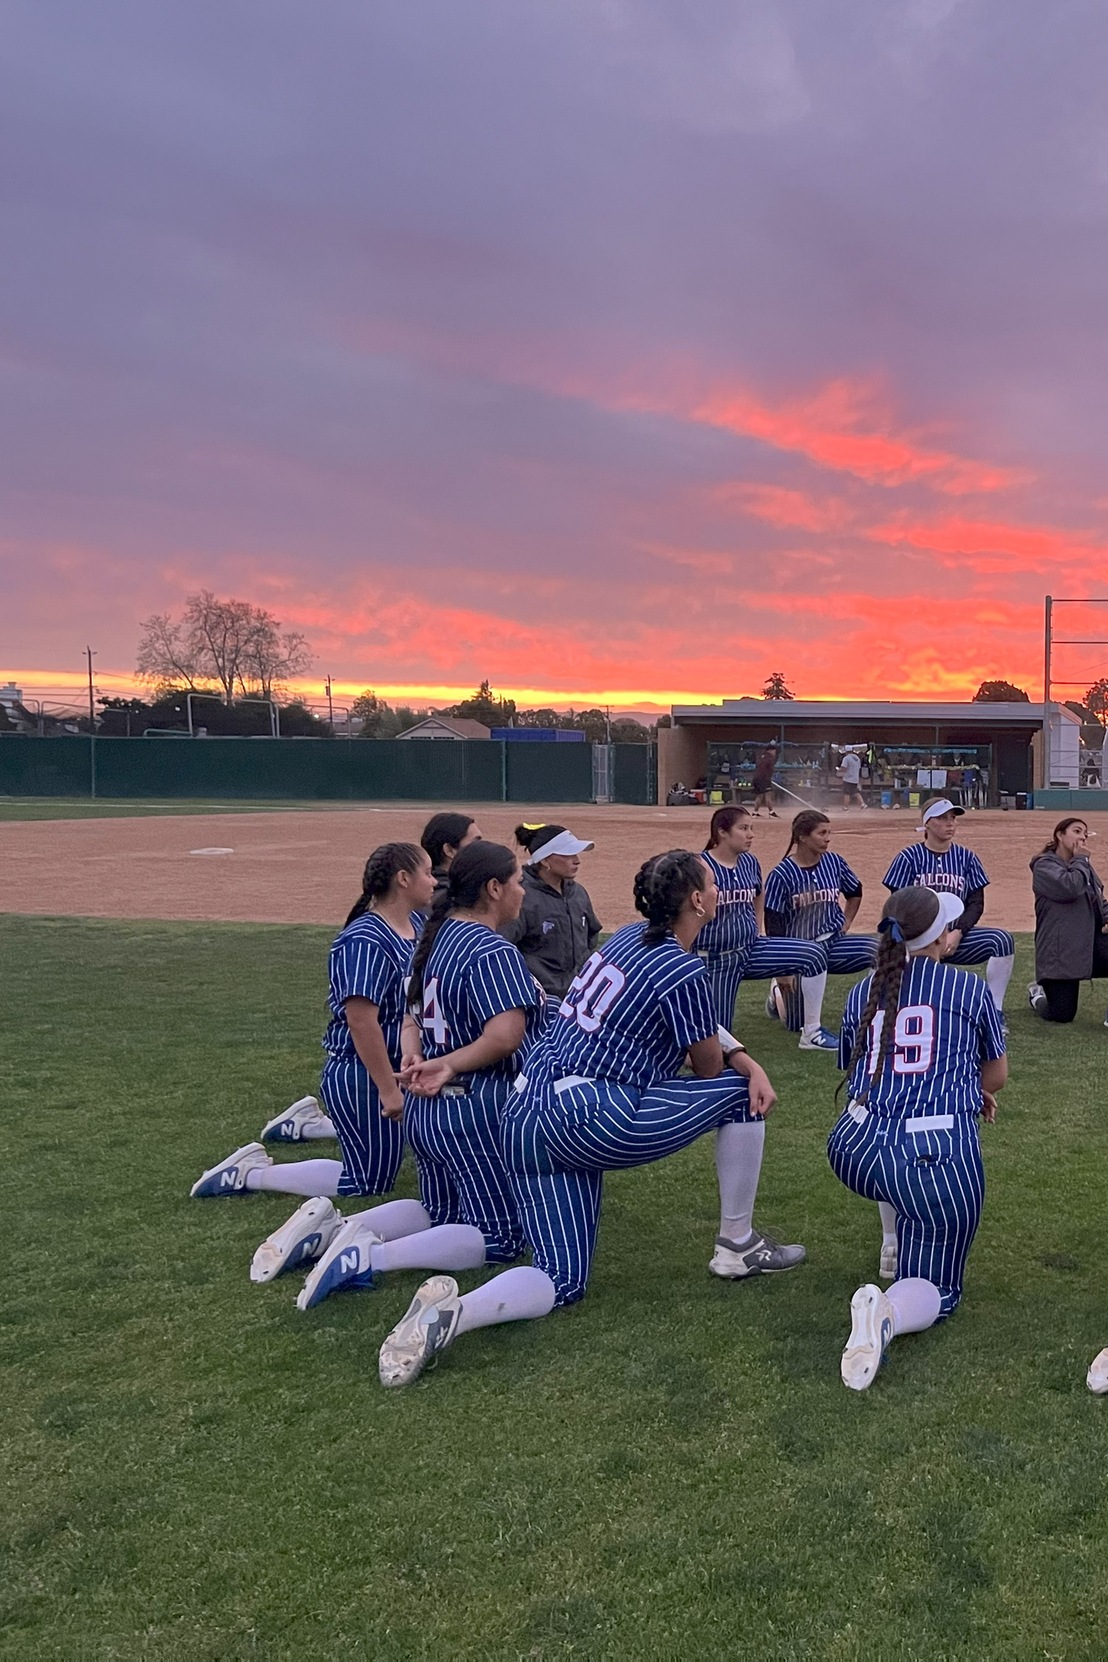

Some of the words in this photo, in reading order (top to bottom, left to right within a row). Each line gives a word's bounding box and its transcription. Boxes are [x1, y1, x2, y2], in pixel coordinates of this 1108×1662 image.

[914, 873, 965, 891] FALCONS
[717, 888, 756, 906] ALCON
[559, 952, 625, 1033] 20
[867, 1004, 934, 1073] 19
[340, 1250, 358, 1274] N
